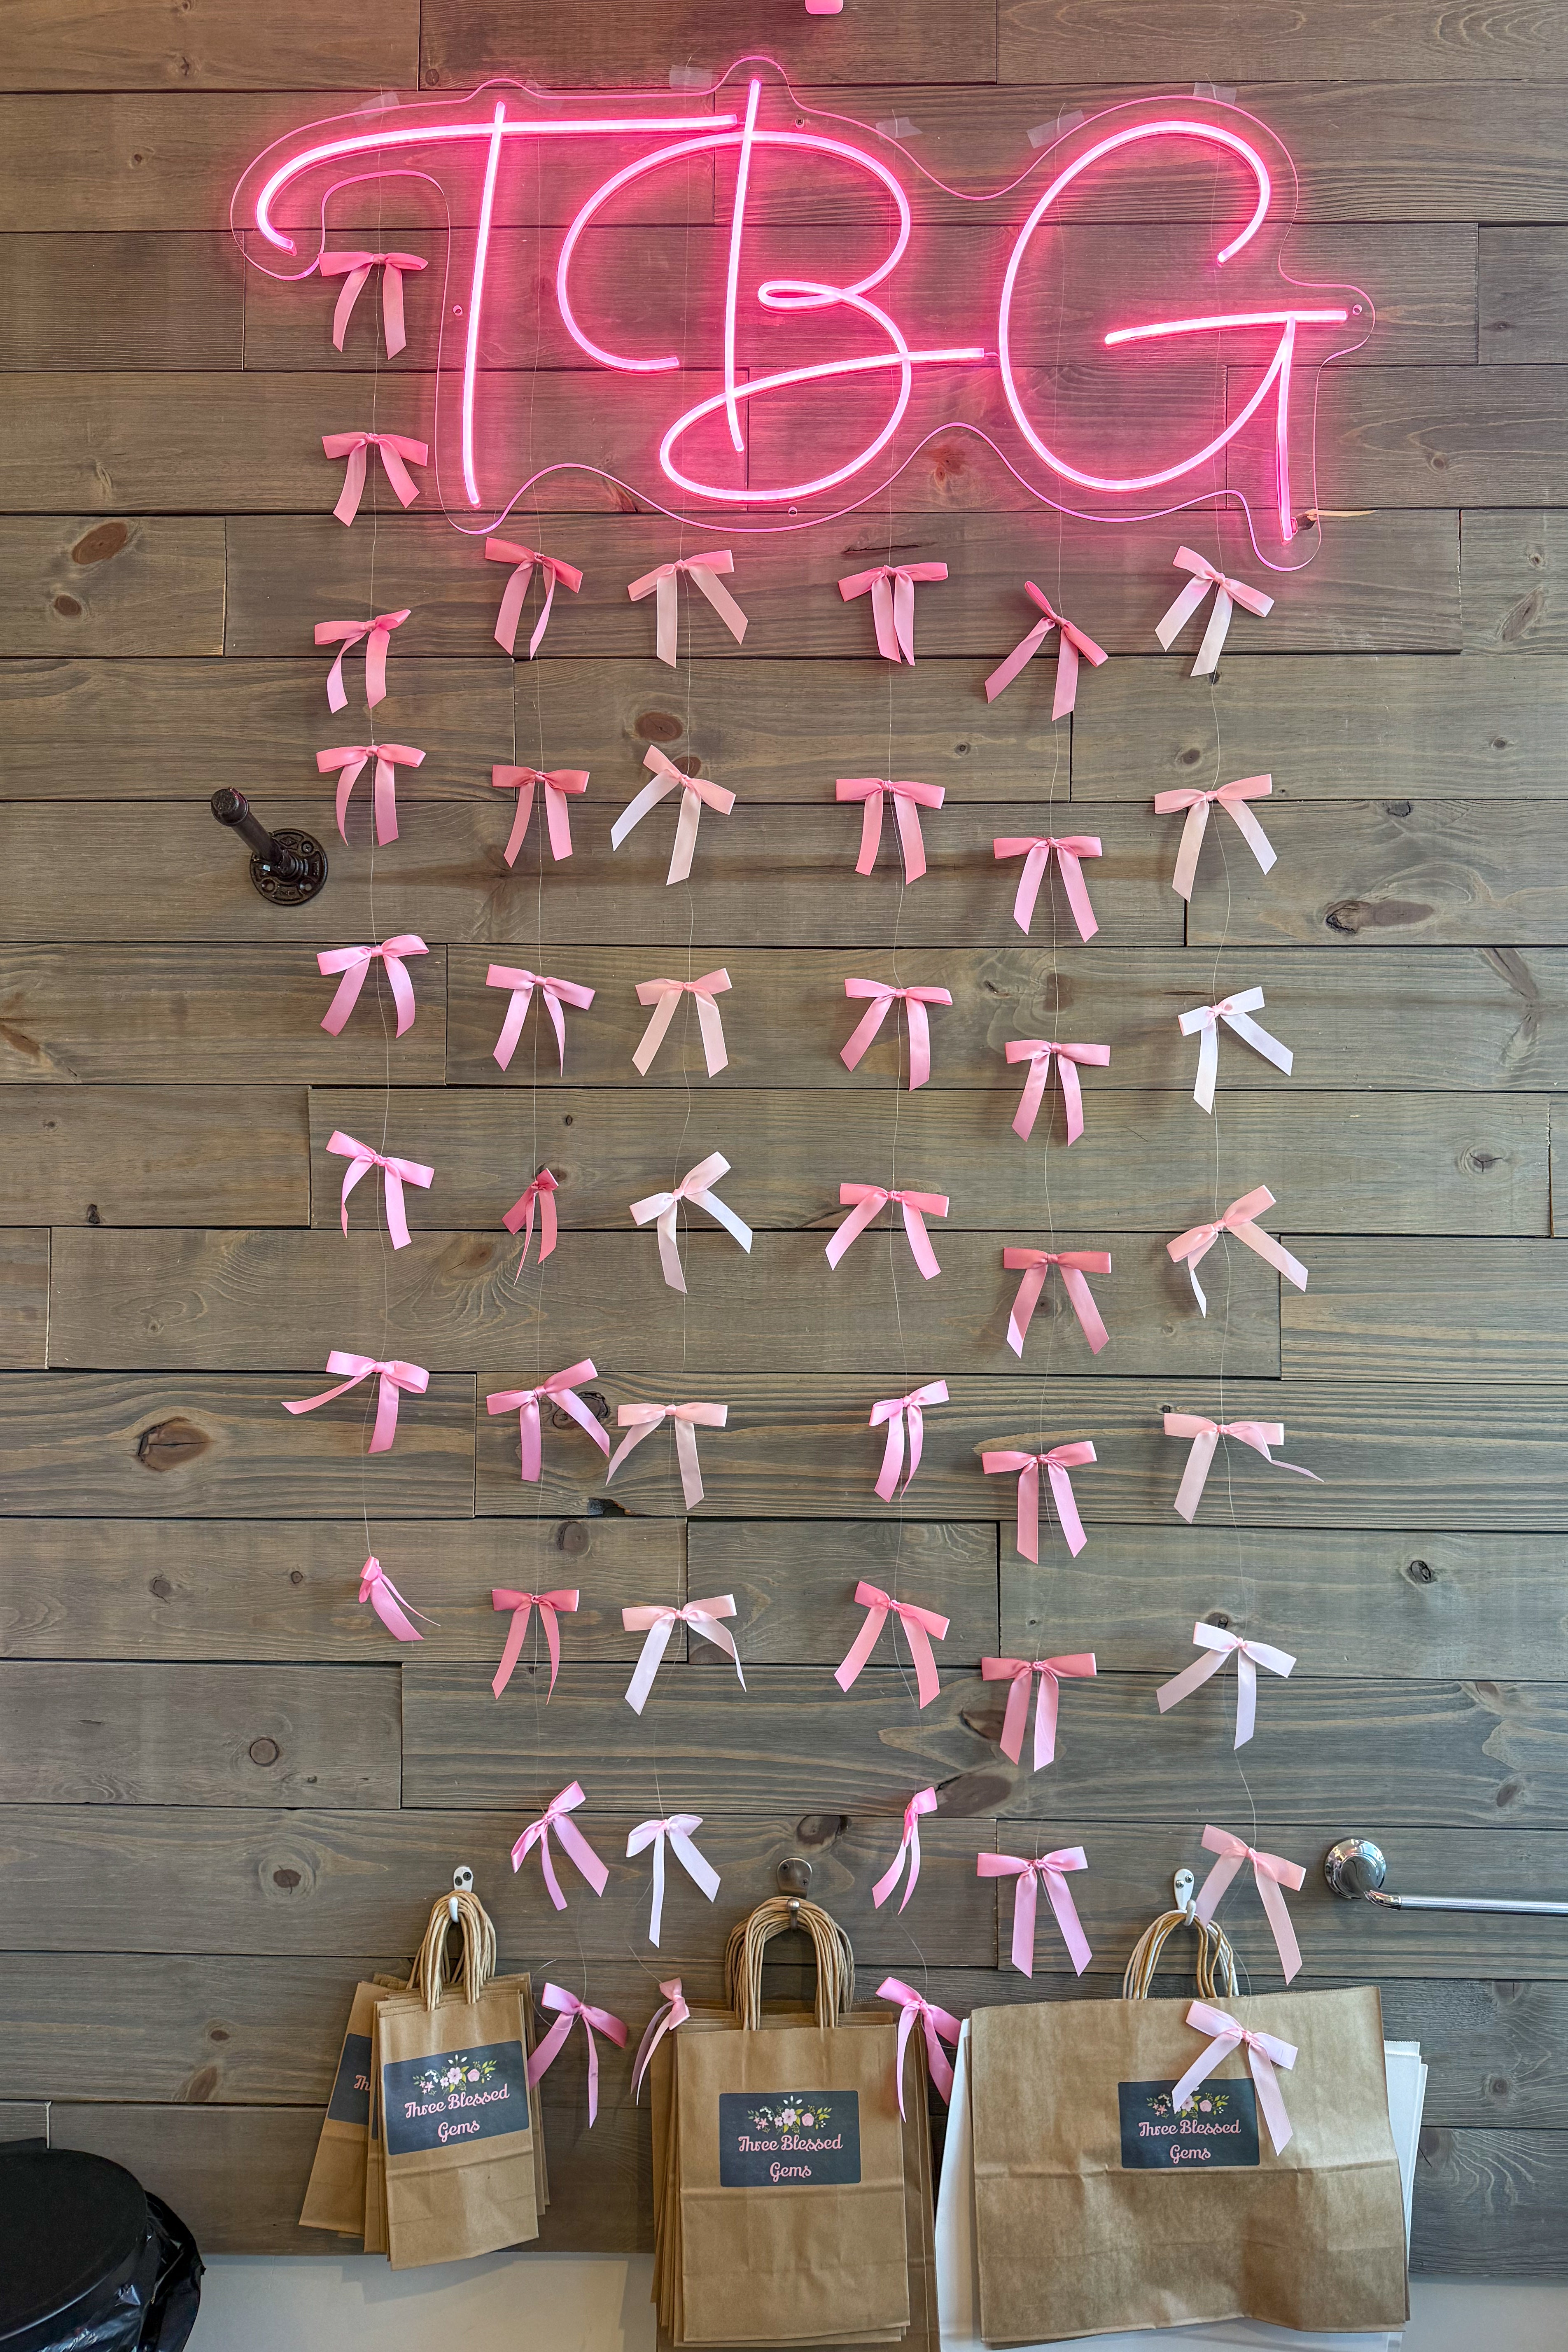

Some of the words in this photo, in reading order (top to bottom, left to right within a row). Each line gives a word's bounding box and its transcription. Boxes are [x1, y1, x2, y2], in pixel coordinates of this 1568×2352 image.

[256, 78, 1350, 541] TBG
[404, 2102, 446, 2118] Three
[448, 2084, 510, 2109] Blessed
[438, 2120, 480, 2143] Gems
[1138, 2122, 1178, 2136] Three
[1180, 2120, 1241, 2135] Blessed
[738, 2136, 779, 2152] Three
[781, 2134, 843, 2151] Blessed
[1170, 2145, 1210, 2164] Gems
[770, 2163, 811, 2182] Gems
